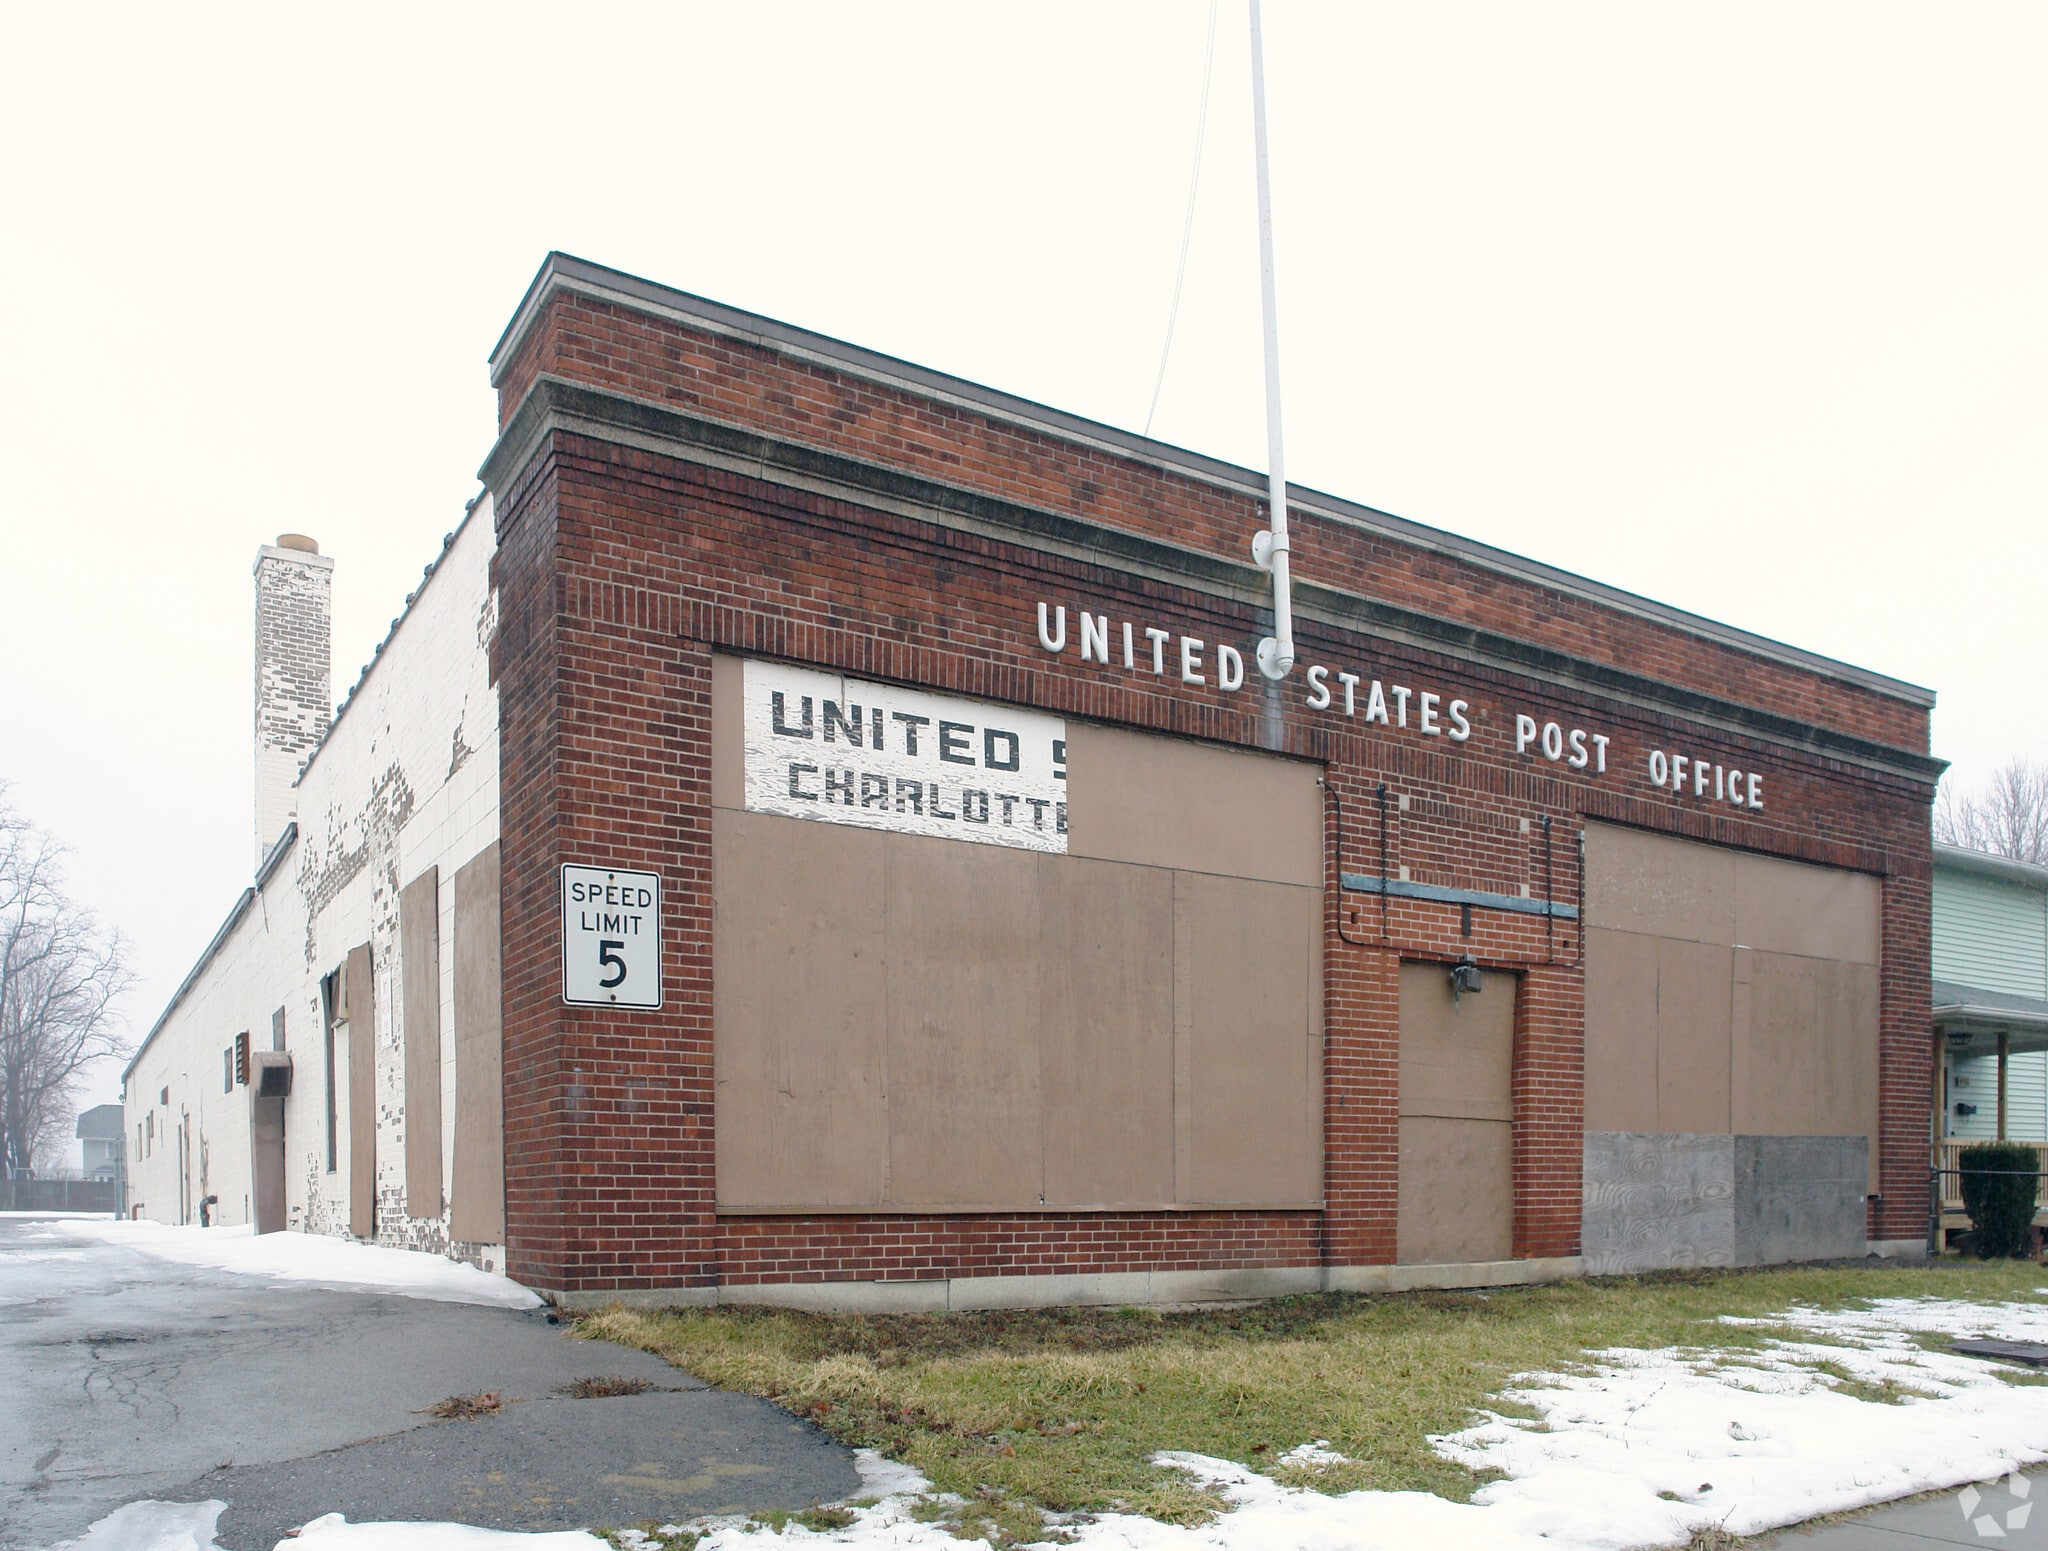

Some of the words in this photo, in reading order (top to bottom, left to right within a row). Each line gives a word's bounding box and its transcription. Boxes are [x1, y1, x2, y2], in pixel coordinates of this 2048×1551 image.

[1037, 602, 1244, 692] UNITED
[1306, 665, 1470, 742] STATES
[1516, 714, 1610, 773] POST
[1649, 750, 1763, 809] OFFICE
[772, 690, 1019, 772] UNITED
[572, 882, 651, 908] SPEED
[582, 911, 642, 935] LIMIT
[599, 940, 627, 988] 5
